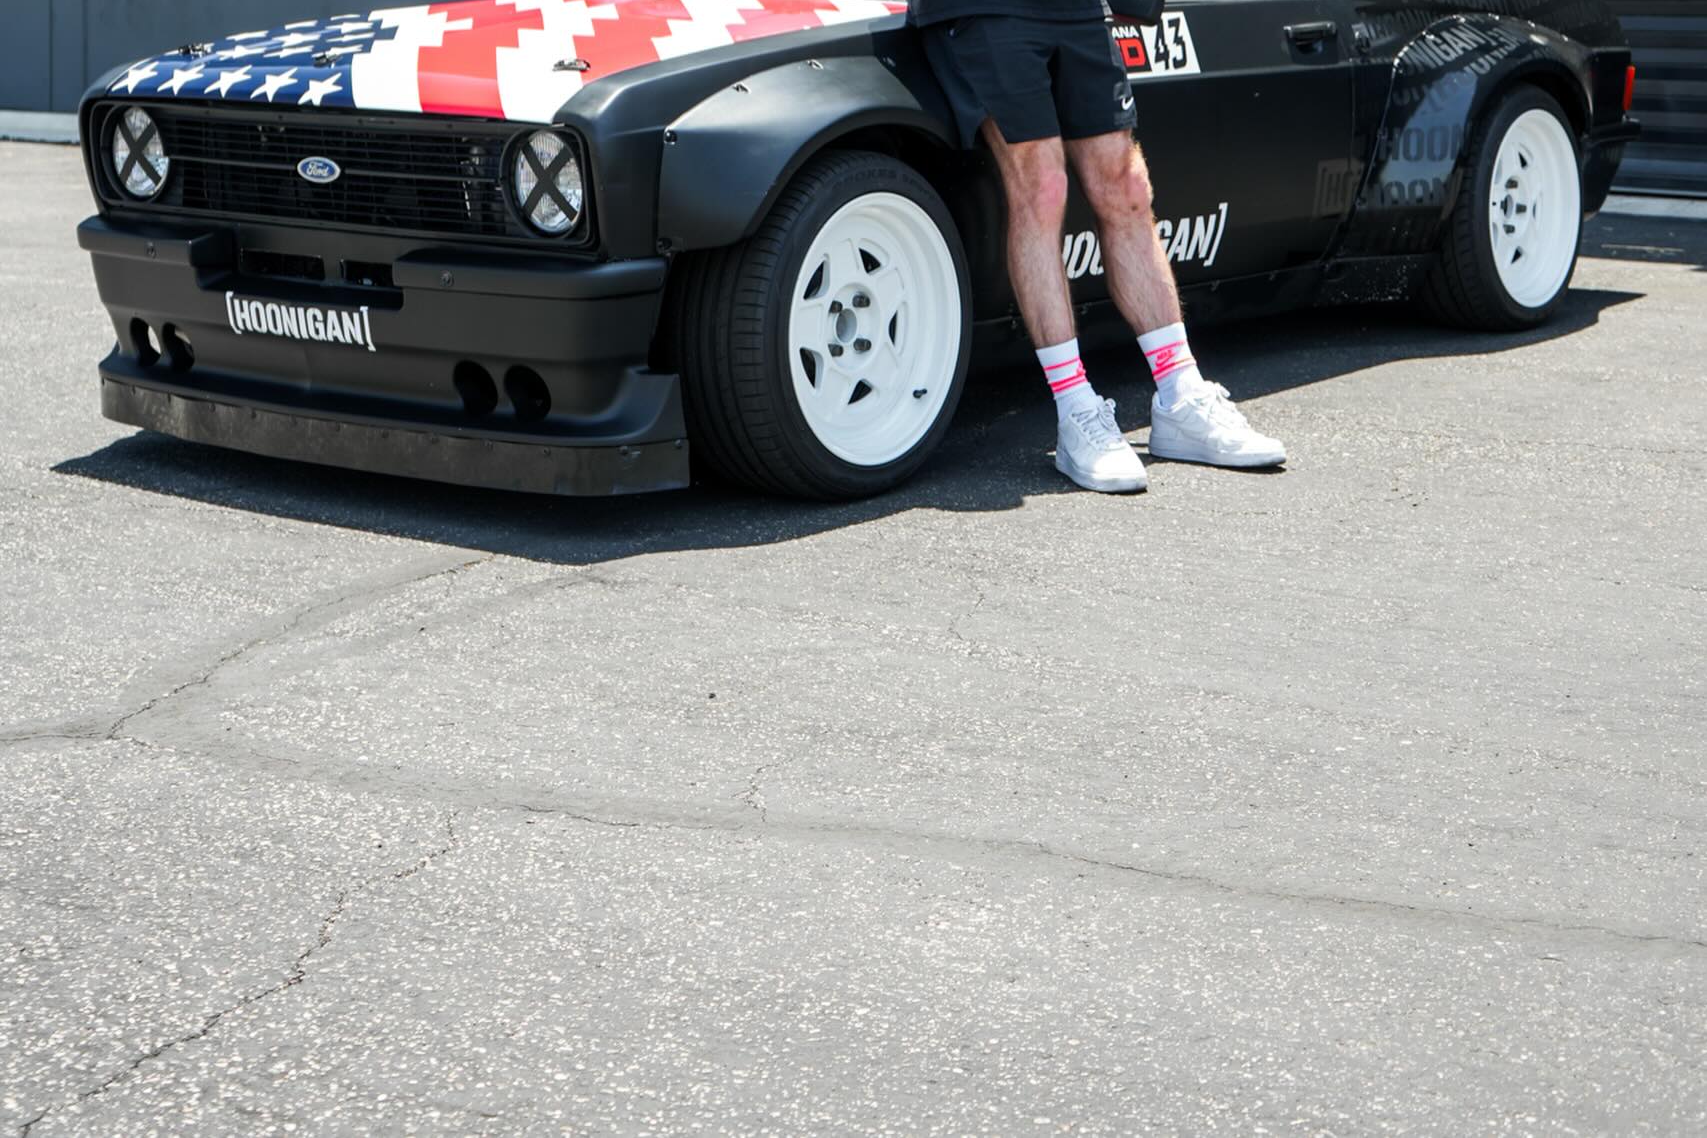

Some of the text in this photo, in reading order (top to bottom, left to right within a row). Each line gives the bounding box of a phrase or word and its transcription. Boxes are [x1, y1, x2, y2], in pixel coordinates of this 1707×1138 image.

[1154, 17, 1188, 71] 43
[306, 161, 330, 177] Ford
[225, 290, 377, 352] [HOONIGAN]
